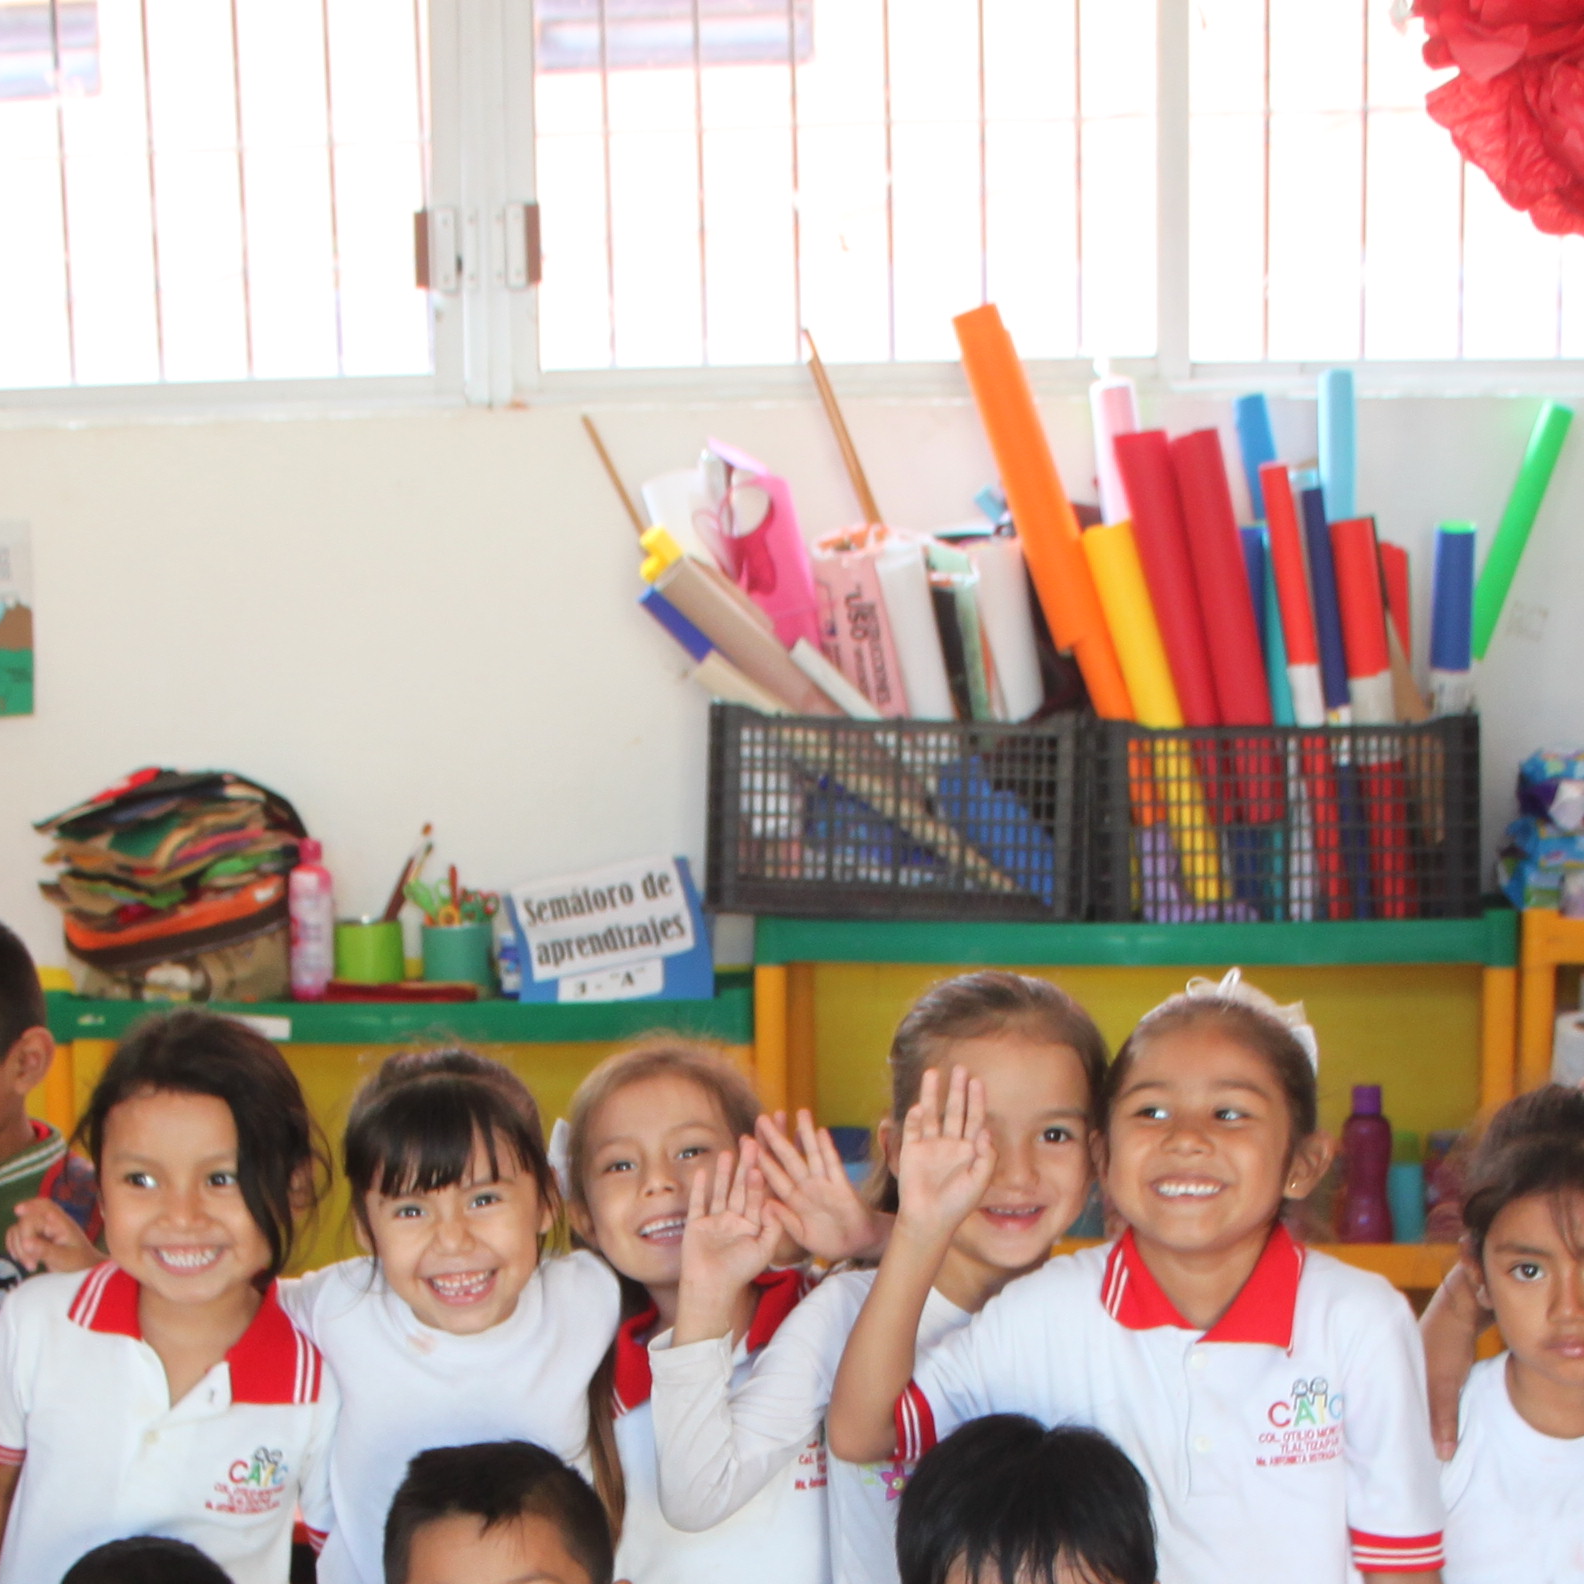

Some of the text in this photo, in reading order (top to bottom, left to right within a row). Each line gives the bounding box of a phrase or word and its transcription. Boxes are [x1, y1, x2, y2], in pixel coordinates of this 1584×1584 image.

[641, 871, 673, 900] de
[535, 913, 686, 967] aprendizajes
[1267, 1394, 1344, 1428] CAIC
[228, 1459, 289, 1488] CAIC
